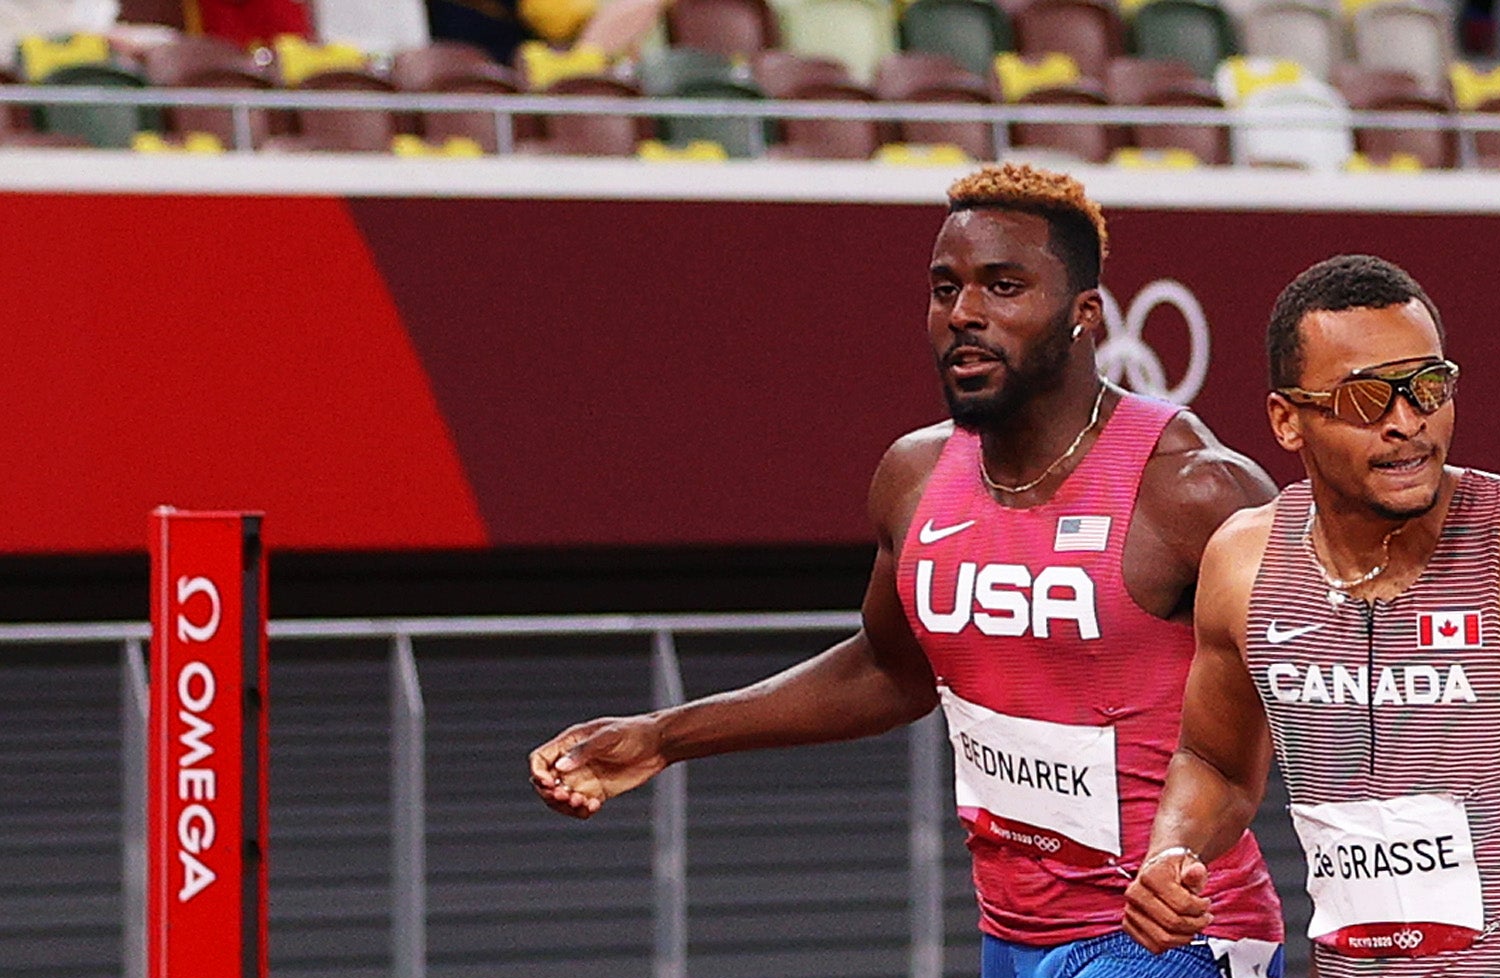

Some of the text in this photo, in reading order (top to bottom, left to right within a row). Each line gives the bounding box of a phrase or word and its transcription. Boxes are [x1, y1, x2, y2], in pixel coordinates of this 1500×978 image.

[916, 560, 1101, 640] USA
[1267, 663, 1478, 706] CANADA
[177, 660, 217, 903] OMEGA
[960, 731, 1092, 797] BEDNAREK
[1337, 835, 1459, 879] GRASSE
